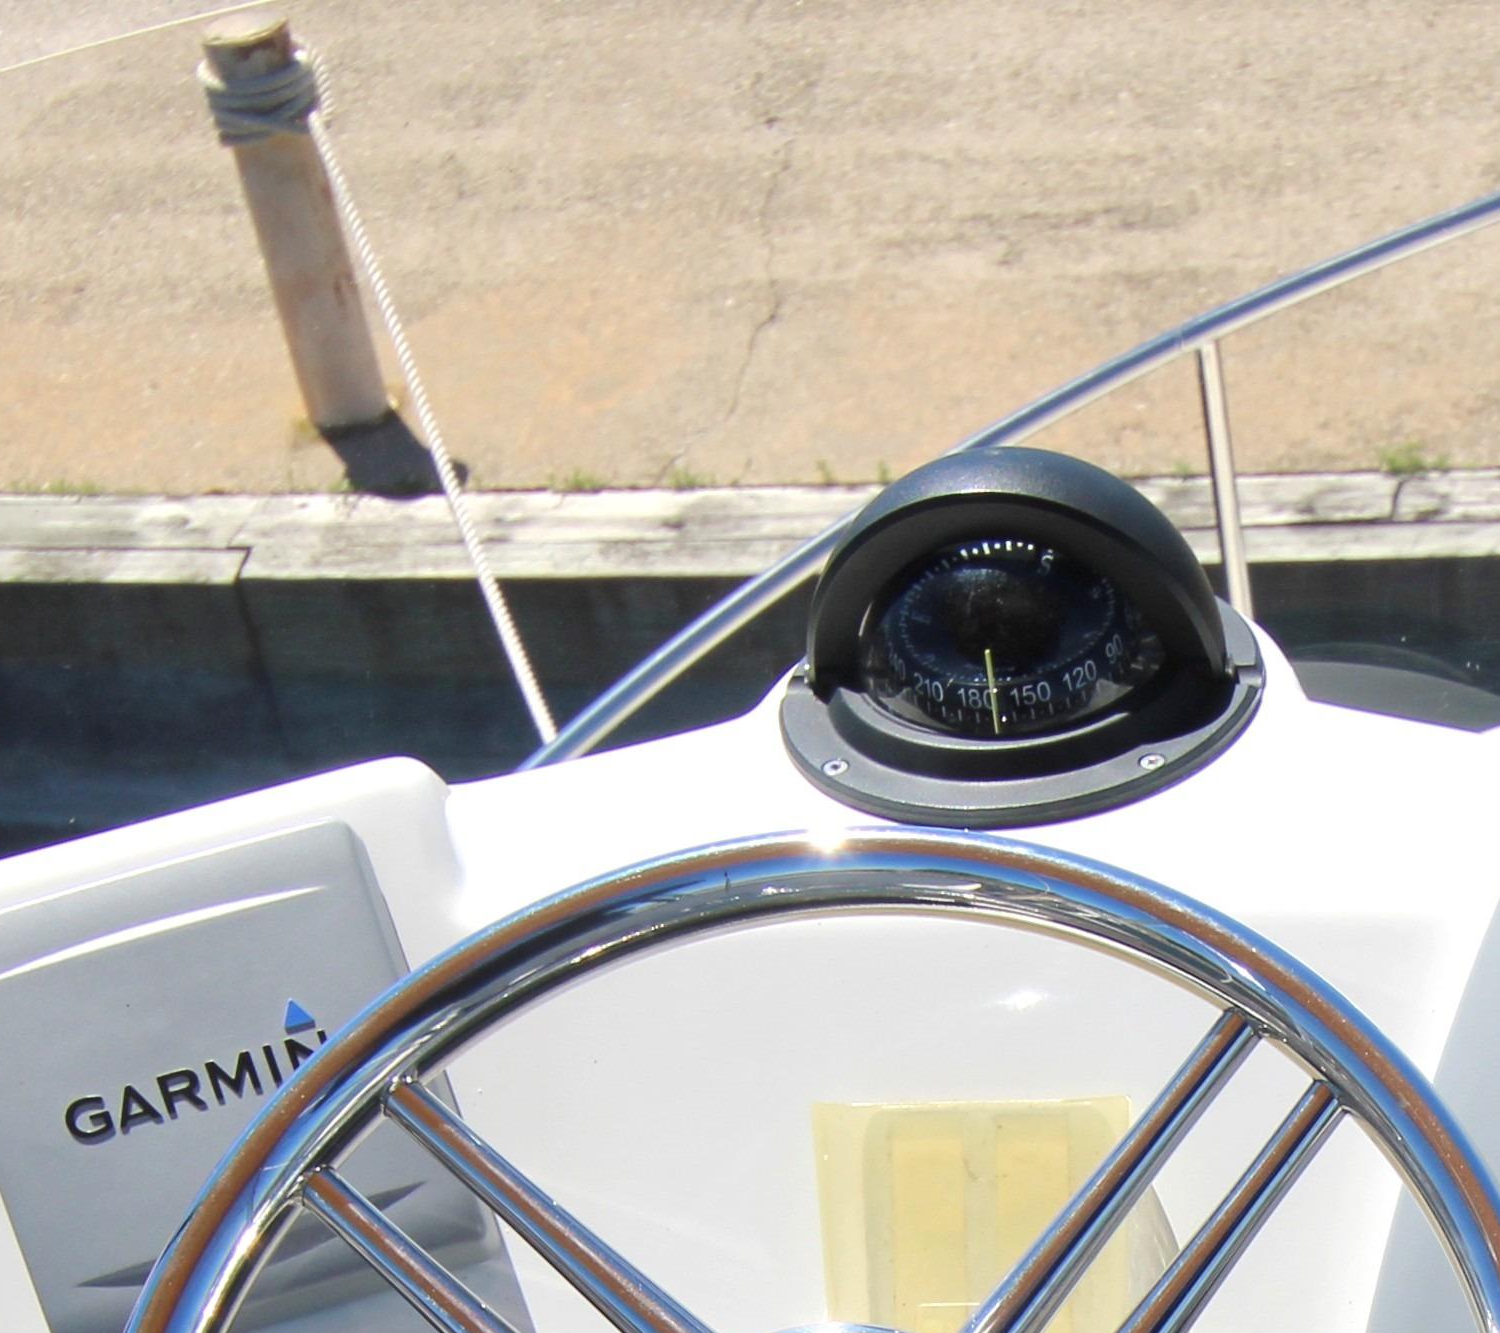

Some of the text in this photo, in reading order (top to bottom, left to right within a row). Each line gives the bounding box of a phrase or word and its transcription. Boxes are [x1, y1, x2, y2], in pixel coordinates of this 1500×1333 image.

[1105, 634, 1125, 664] 90
[913, 672, 943, 702] 210
[1062, 660, 1097, 693] 120
[957, 687, 994, 711] 180
[1009, 680, 1051, 705] 150
